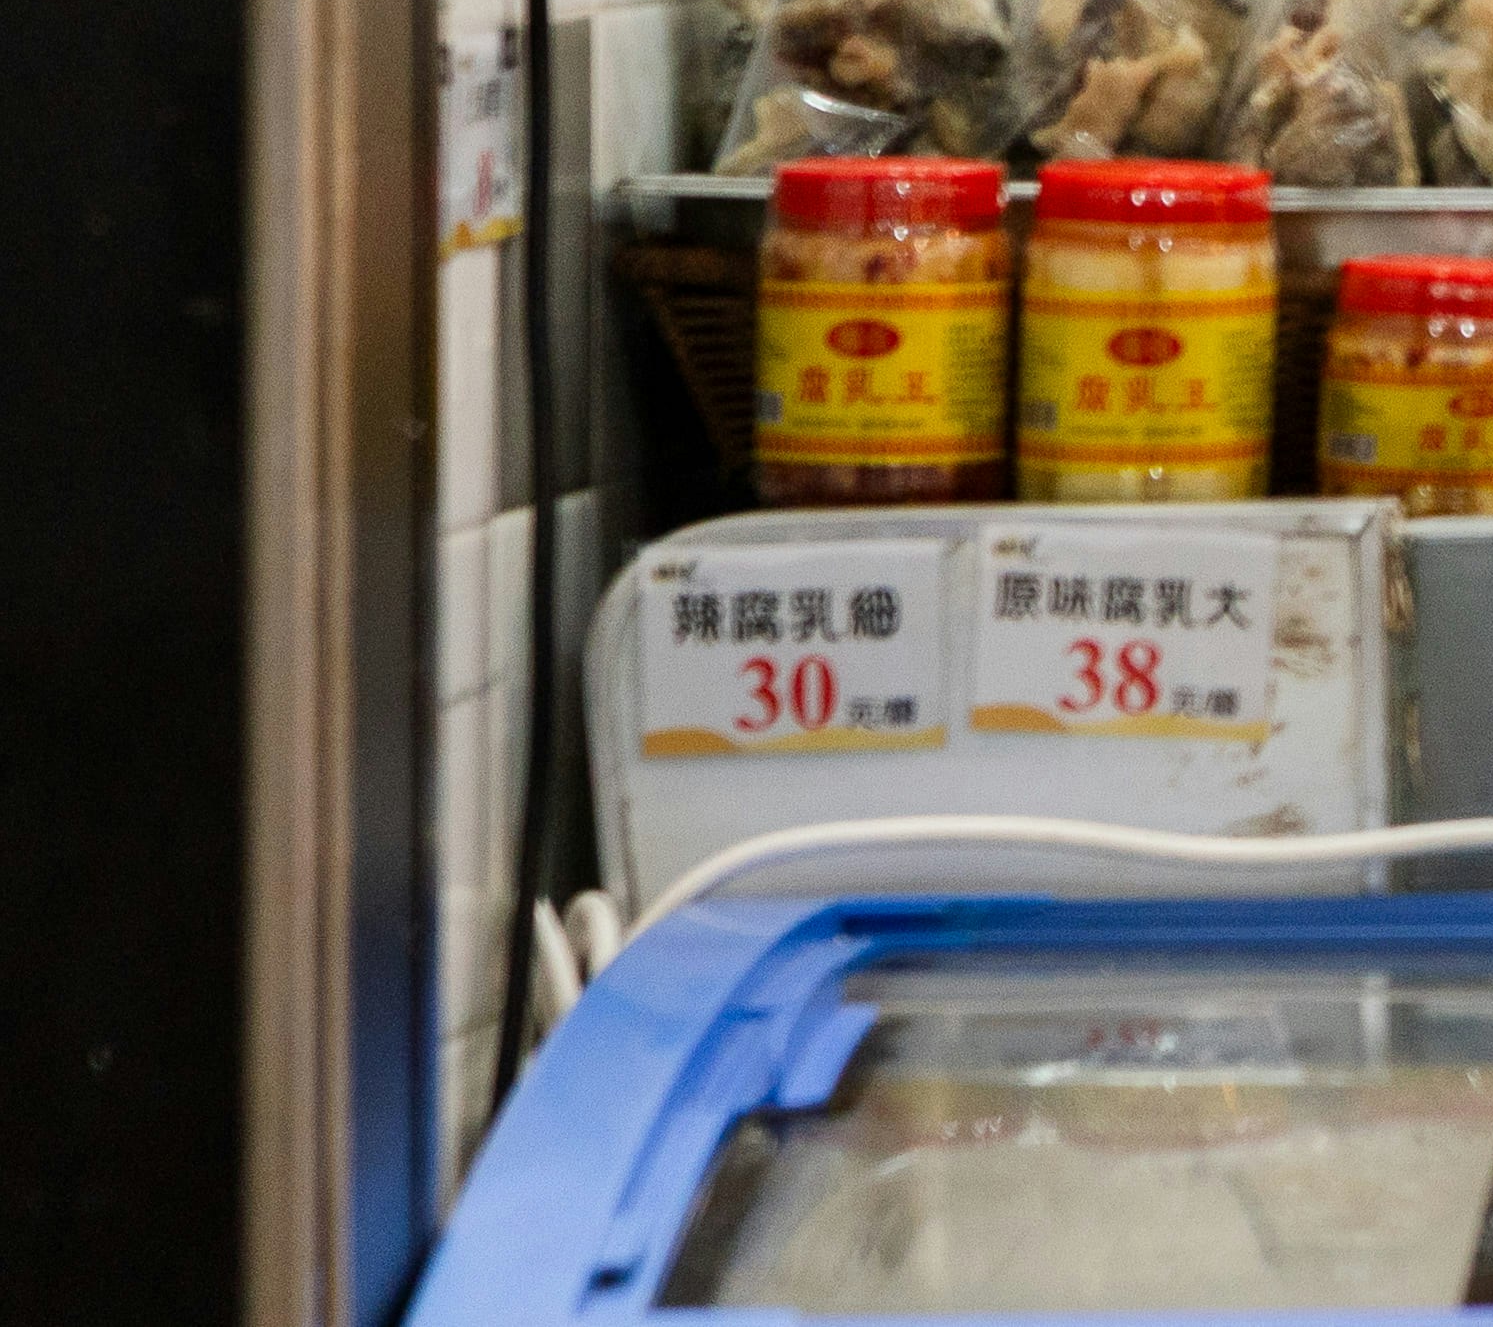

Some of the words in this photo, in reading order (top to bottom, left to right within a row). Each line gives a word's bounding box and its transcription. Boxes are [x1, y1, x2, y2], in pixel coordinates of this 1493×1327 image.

[997, 570, 1252, 629] 原味腐乳大
[733, 654, 837, 732] 30
[1056, 636, 1161, 715] 38
